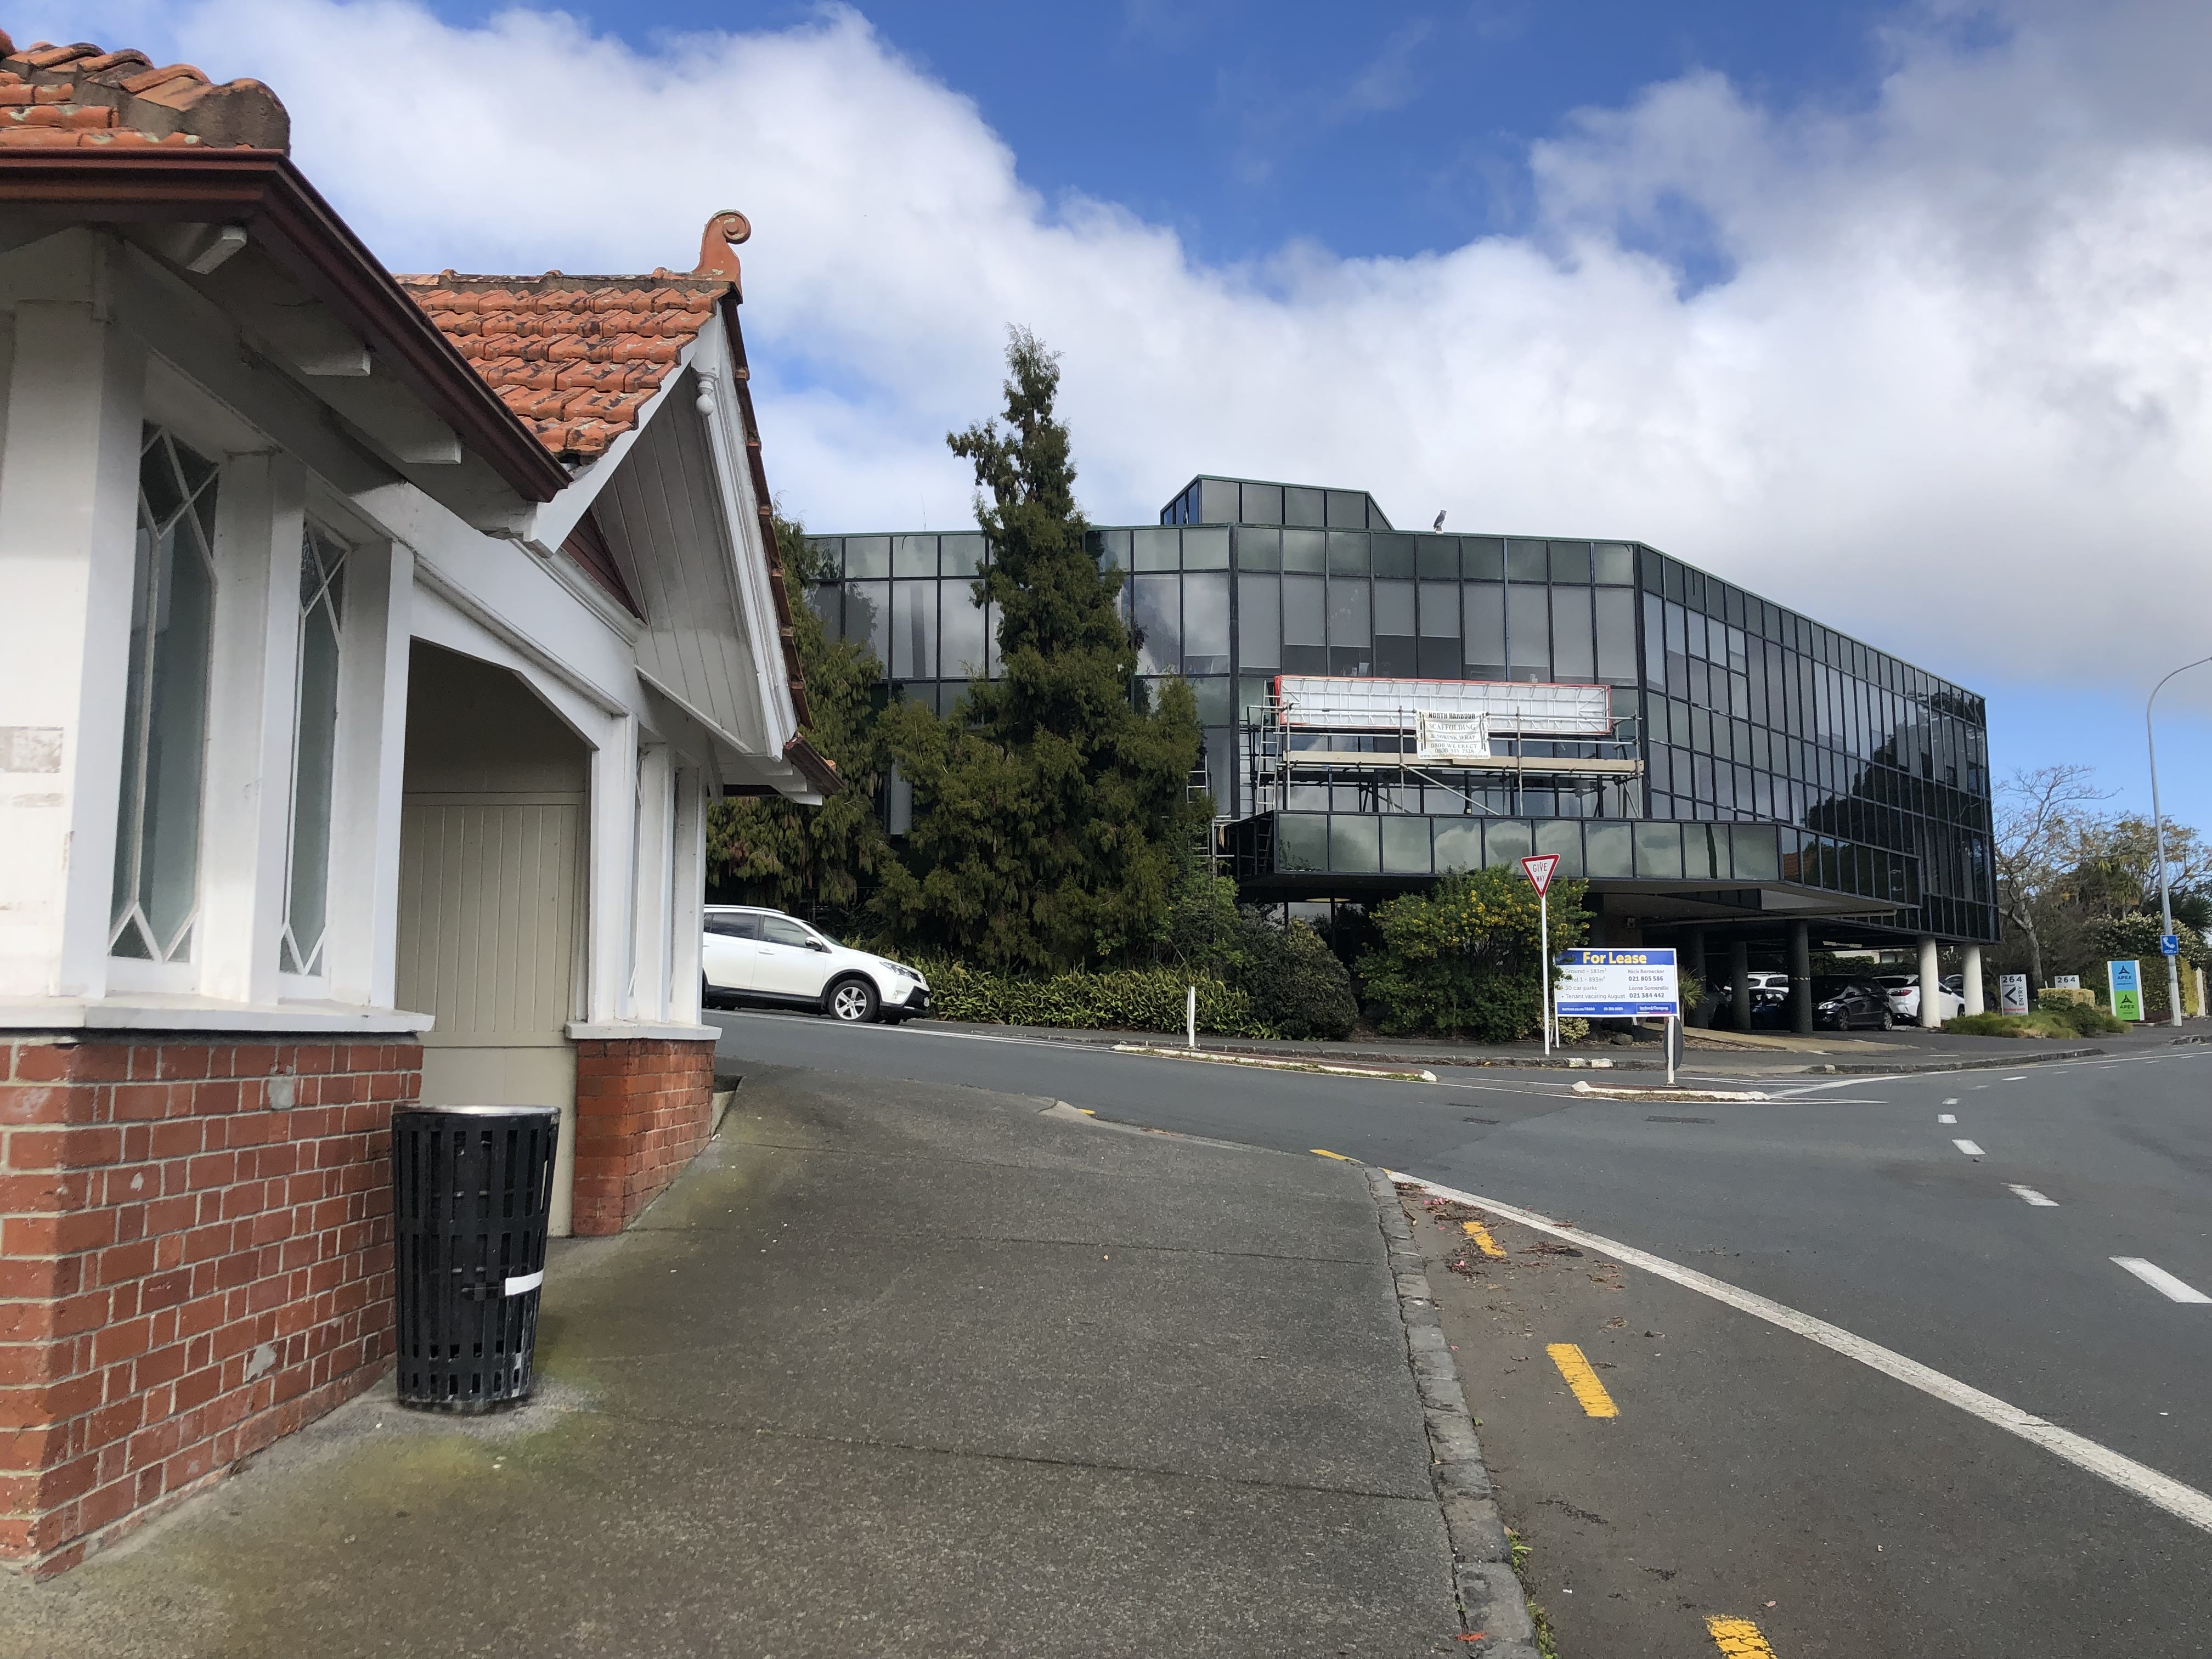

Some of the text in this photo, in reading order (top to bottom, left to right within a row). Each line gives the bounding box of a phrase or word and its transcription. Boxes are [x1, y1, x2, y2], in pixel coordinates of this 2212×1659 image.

[1533, 862, 1548, 872] GIVE
[1583, 952, 1647, 964] For Lease
